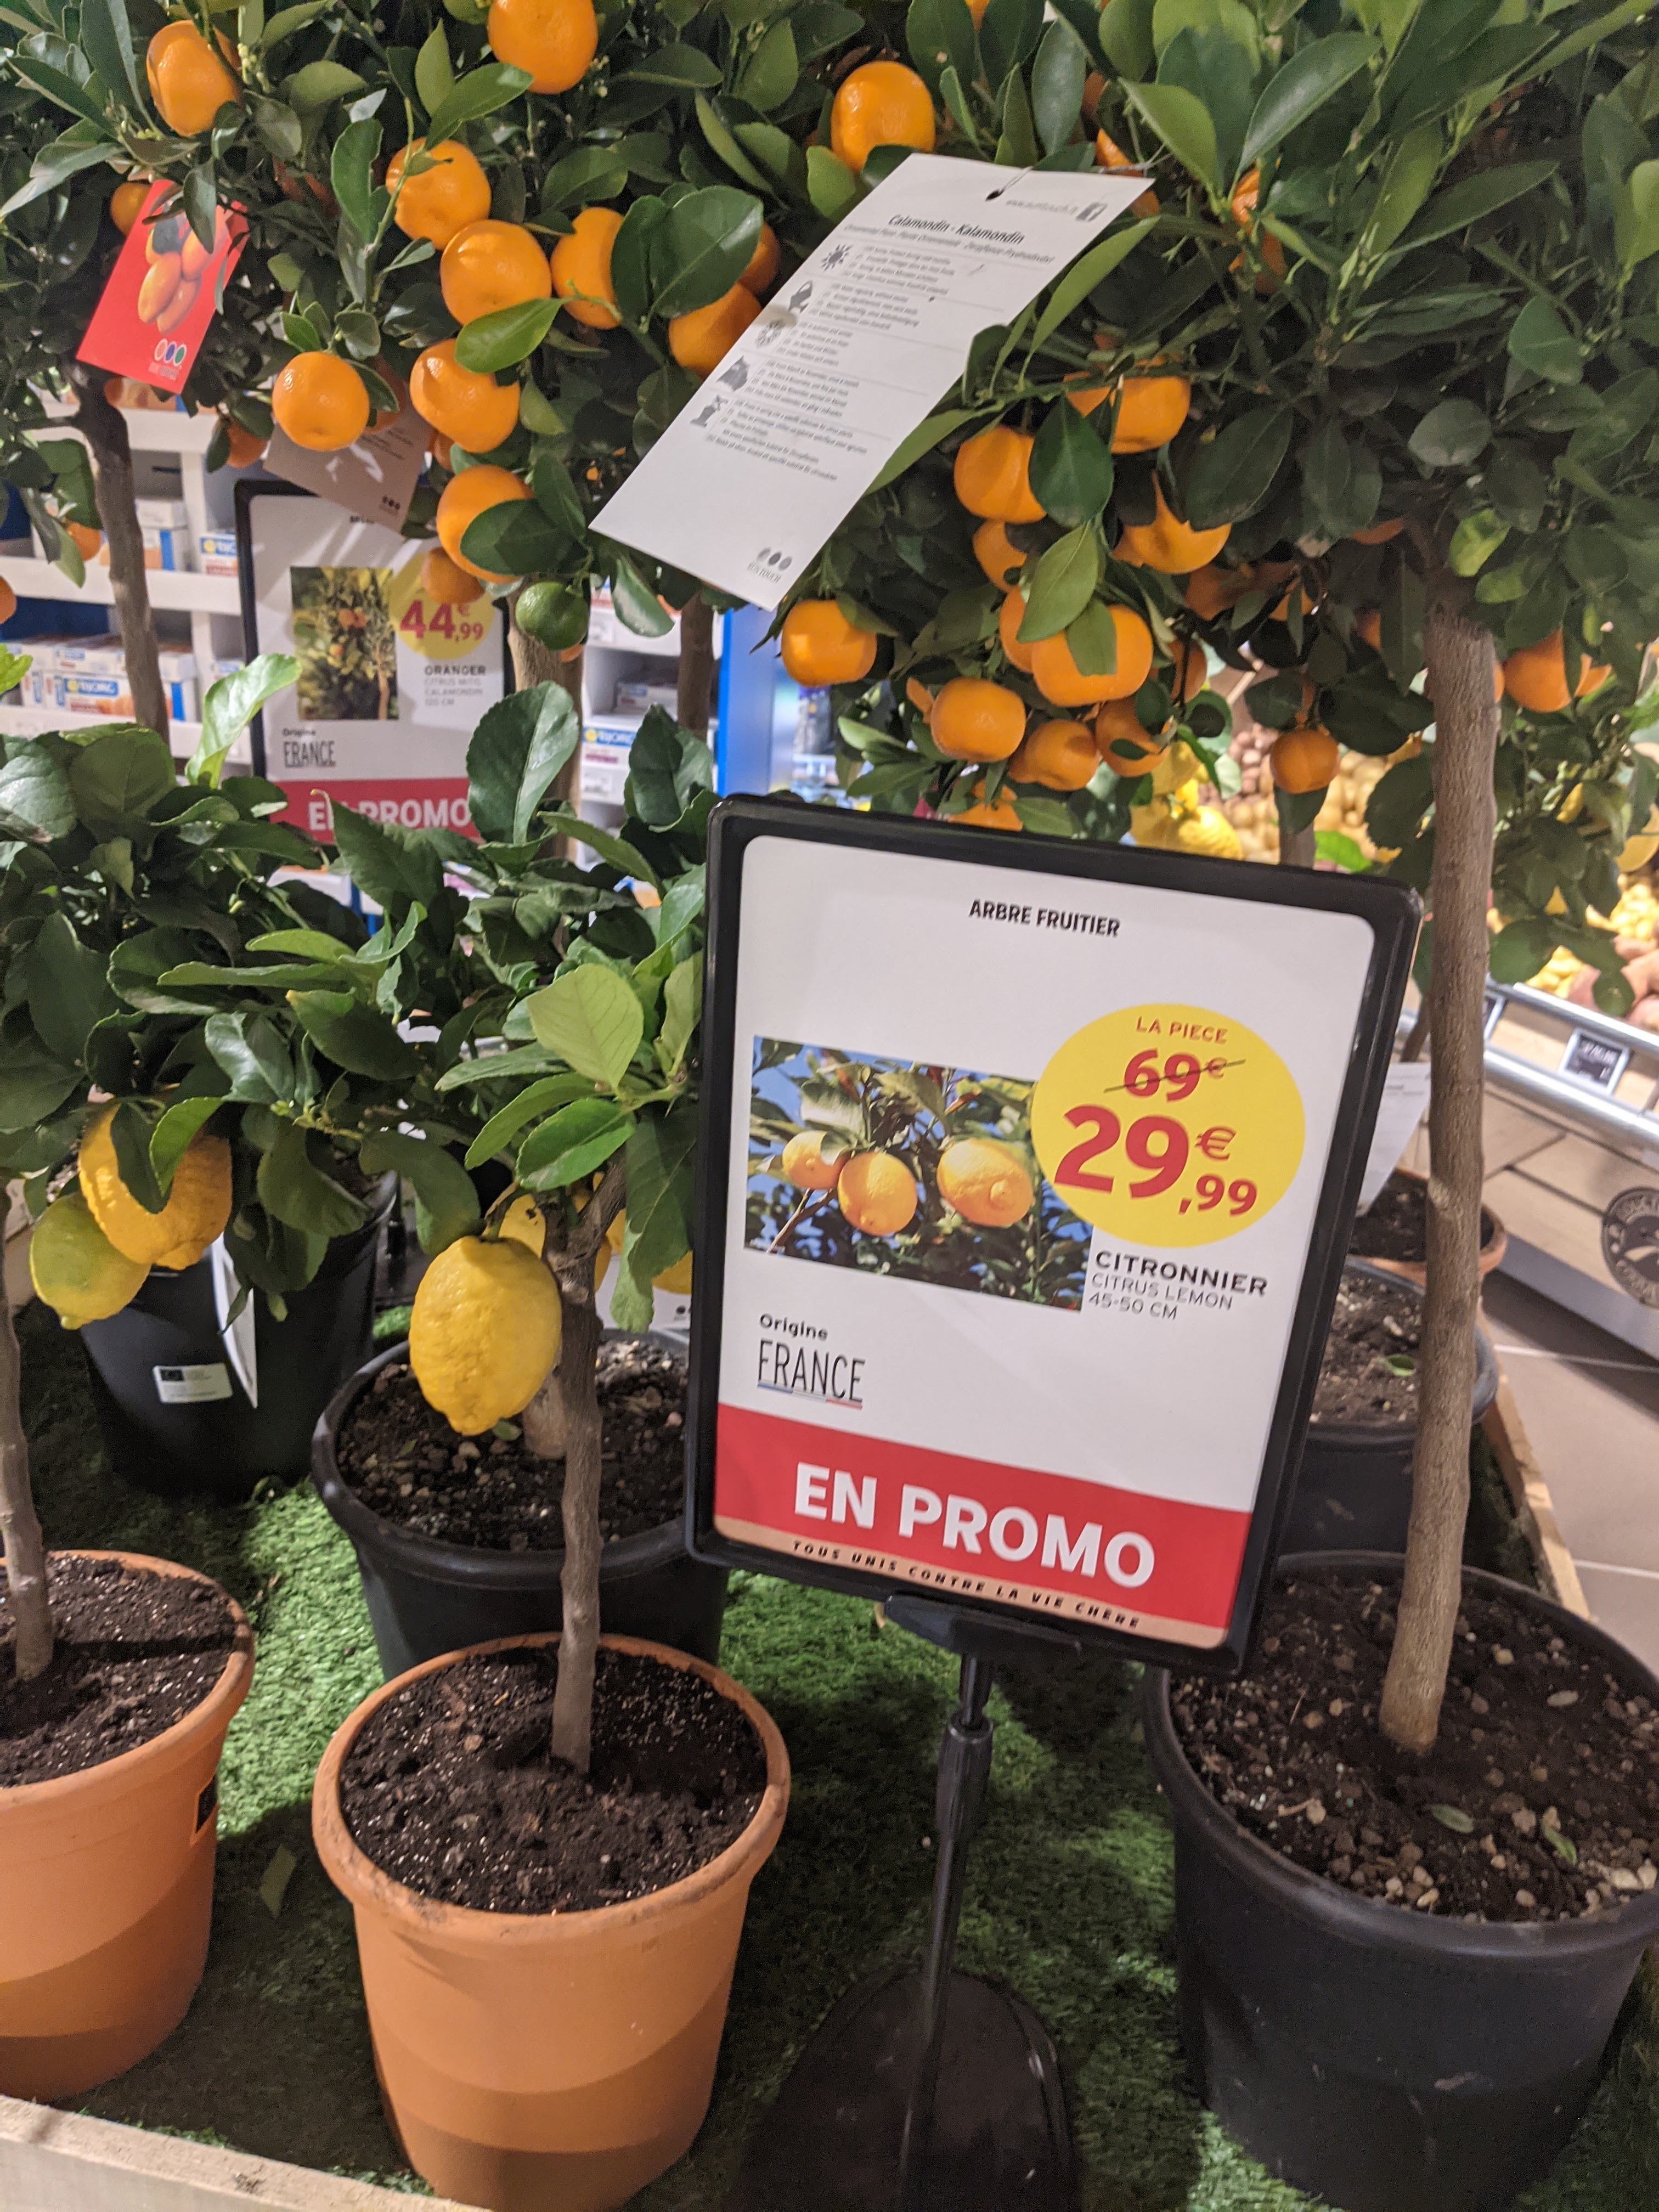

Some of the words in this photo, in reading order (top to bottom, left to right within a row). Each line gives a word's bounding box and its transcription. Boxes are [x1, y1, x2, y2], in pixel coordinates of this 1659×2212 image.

[888, 215, 950, 232] Calamondin
[955, 223, 1025, 244] Kalamondin
[425, 664, 486, 675] ORANGER
[283, 741, 336, 766] FRANCE
[969, 900, 1031, 924] ARBRE
[1036, 909, 1121, 937] FRUITIER
[1136, 1015, 1161, 1035] LA
[1169, 1022, 1228, 1044] PIECE
[1095, 1251, 1267, 1296] CITRONNIER
[1088, 1293, 1145, 1315] 45-50
[1149, 1301, 1178, 1321] CM
[1091, 1274, 1160, 1299] CITRUS
[1165, 1284, 1233, 1311] LEMON
[759, 1313, 828, 1341] Origine
[757, 1338, 866, 1403] FRANCE
[794, 1462, 877, 1529] EN
[899, 1483, 1155, 1589] PROMO
[793, 1541, 839, 1560] TOUS
[851, 1553, 898, 1572] UNIS
[909, 1565, 987, 1592] CONTRE
[995, 1585, 1019, 1599] LA
[1031, 1591, 1063, 1608] VIE
